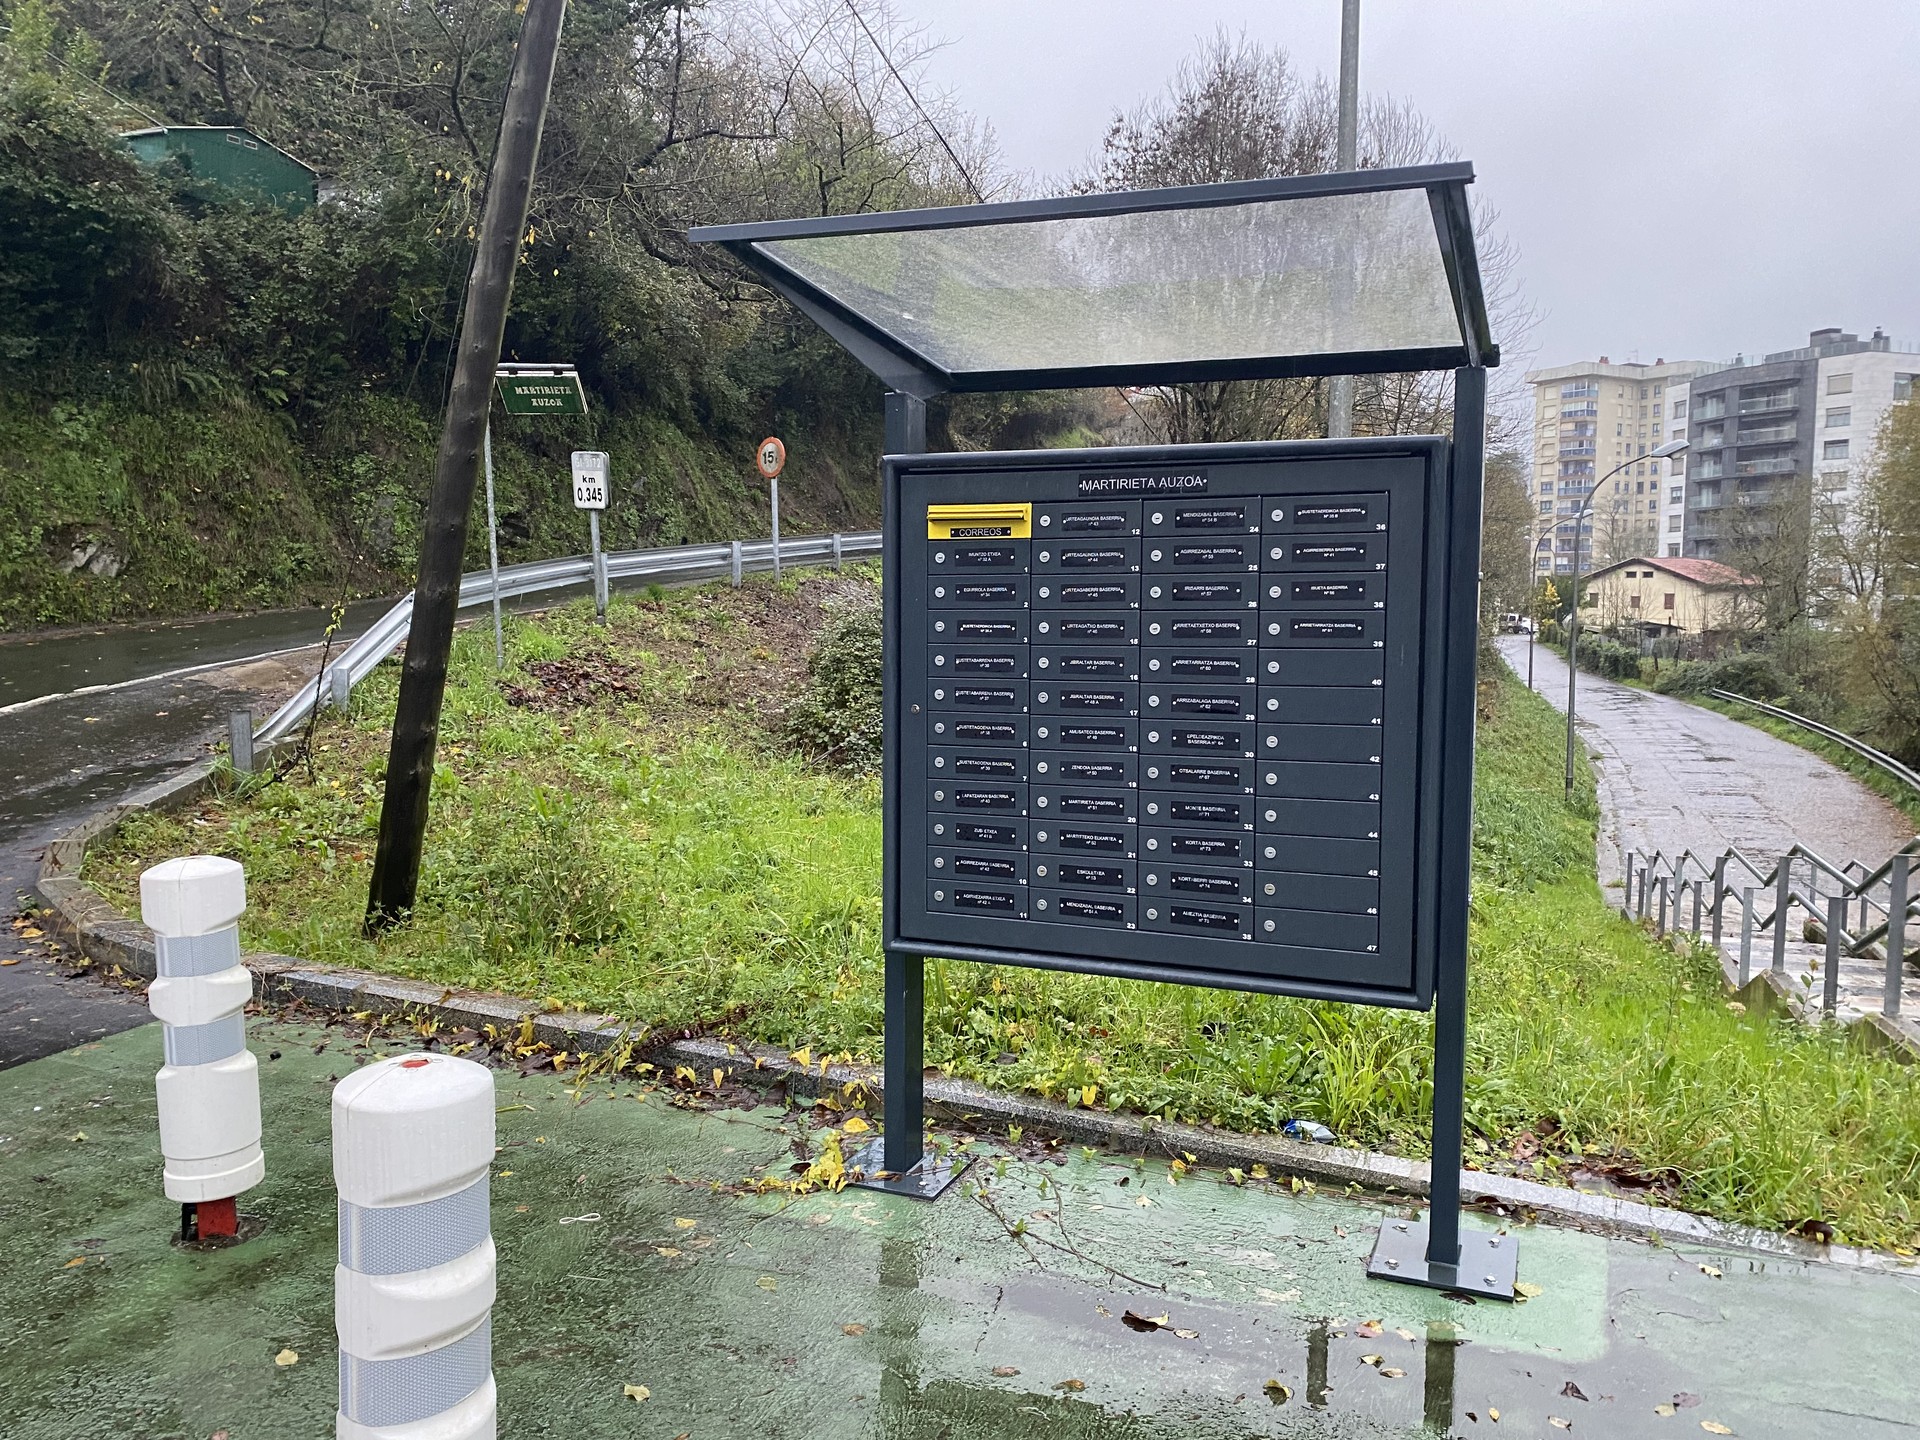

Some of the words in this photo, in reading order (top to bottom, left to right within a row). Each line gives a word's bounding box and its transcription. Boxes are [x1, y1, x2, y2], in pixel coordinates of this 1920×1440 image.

[763, 451, 774, 464] 15
[1082, 478, 1156, 491] MARTIRIETA
[1160, 476, 1202, 488] AUZOA
[578, 488, 602, 502] 0,345
[959, 528, 1002, 536] CORREOS
